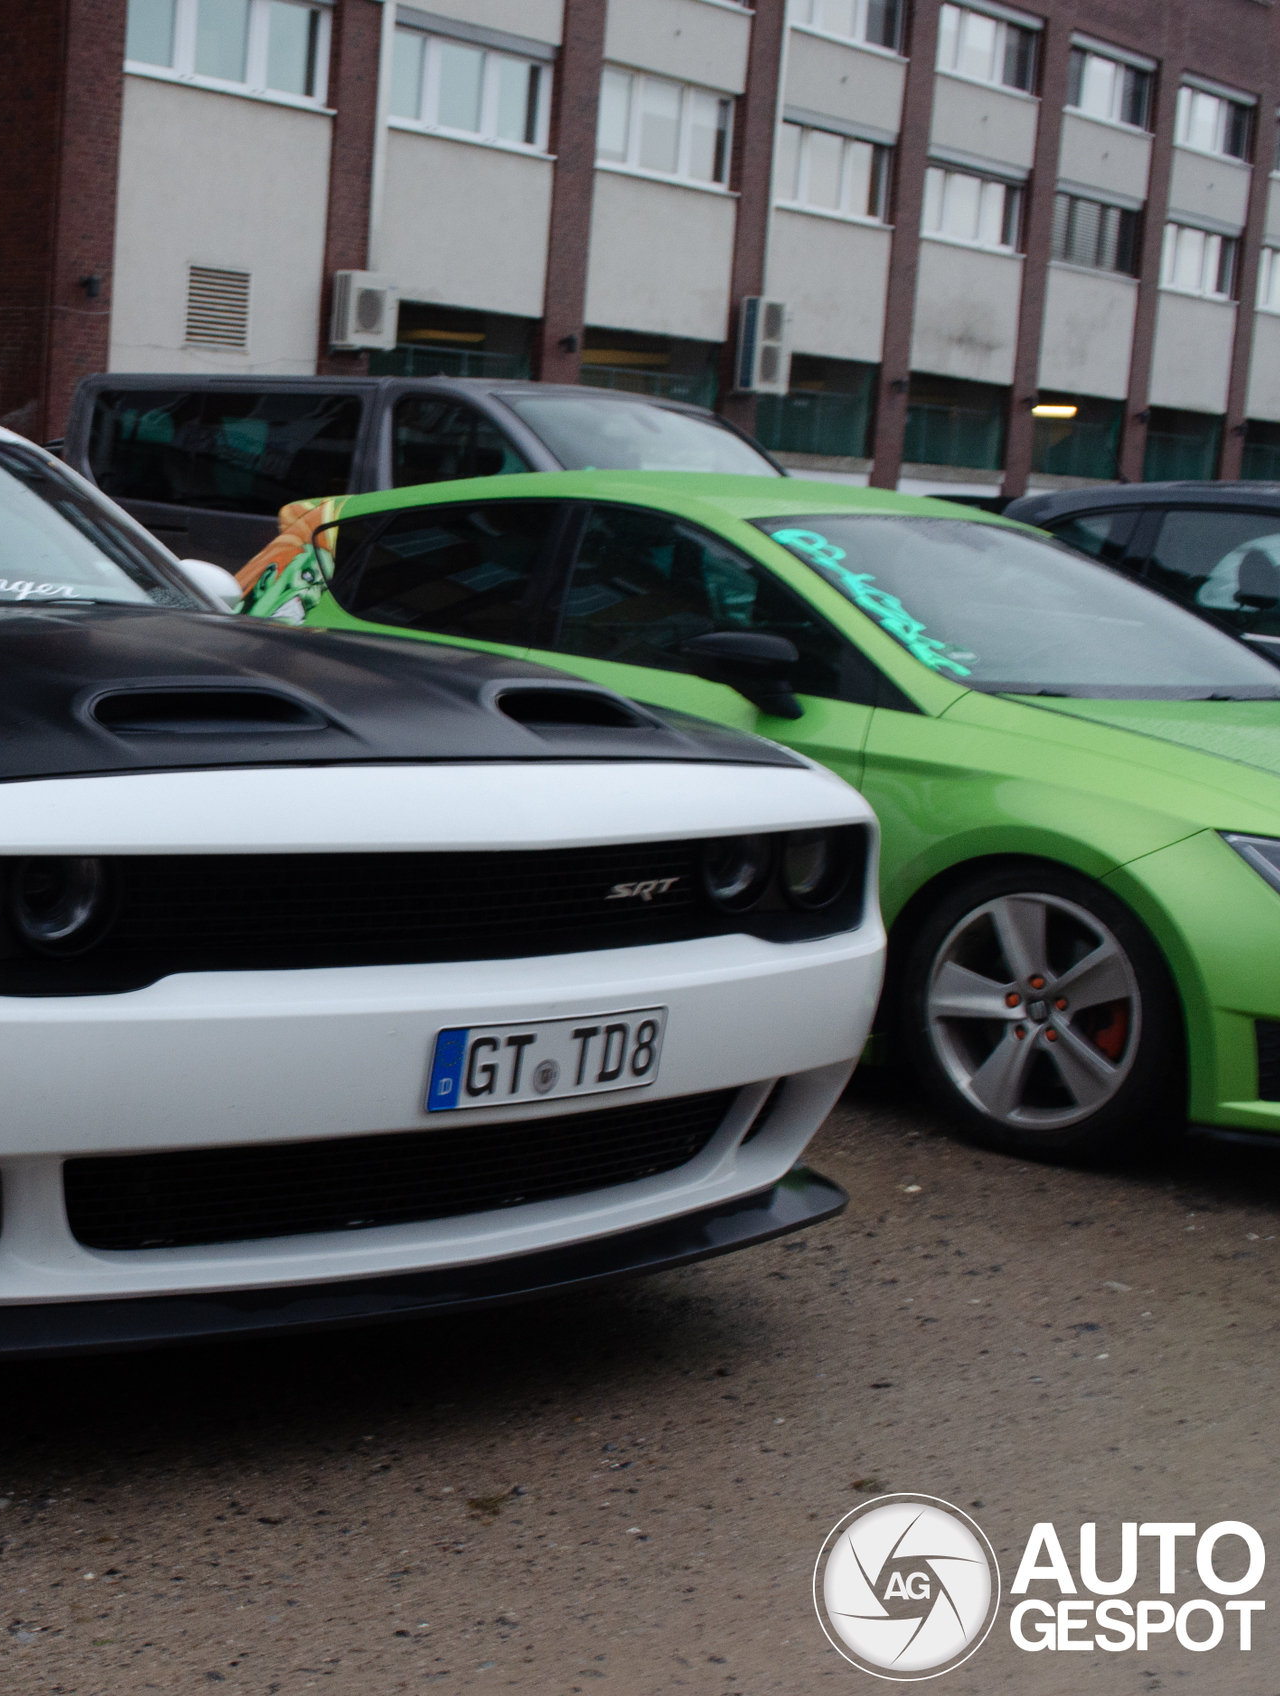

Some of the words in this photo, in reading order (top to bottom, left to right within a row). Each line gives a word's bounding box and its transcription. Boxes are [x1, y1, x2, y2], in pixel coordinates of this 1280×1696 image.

[605, 876, 681, 901] SRT
[465, 1032, 537, 1097] GT
[572, 1018, 659, 1086] TD8
[437, 1077, 453, 1096] D
